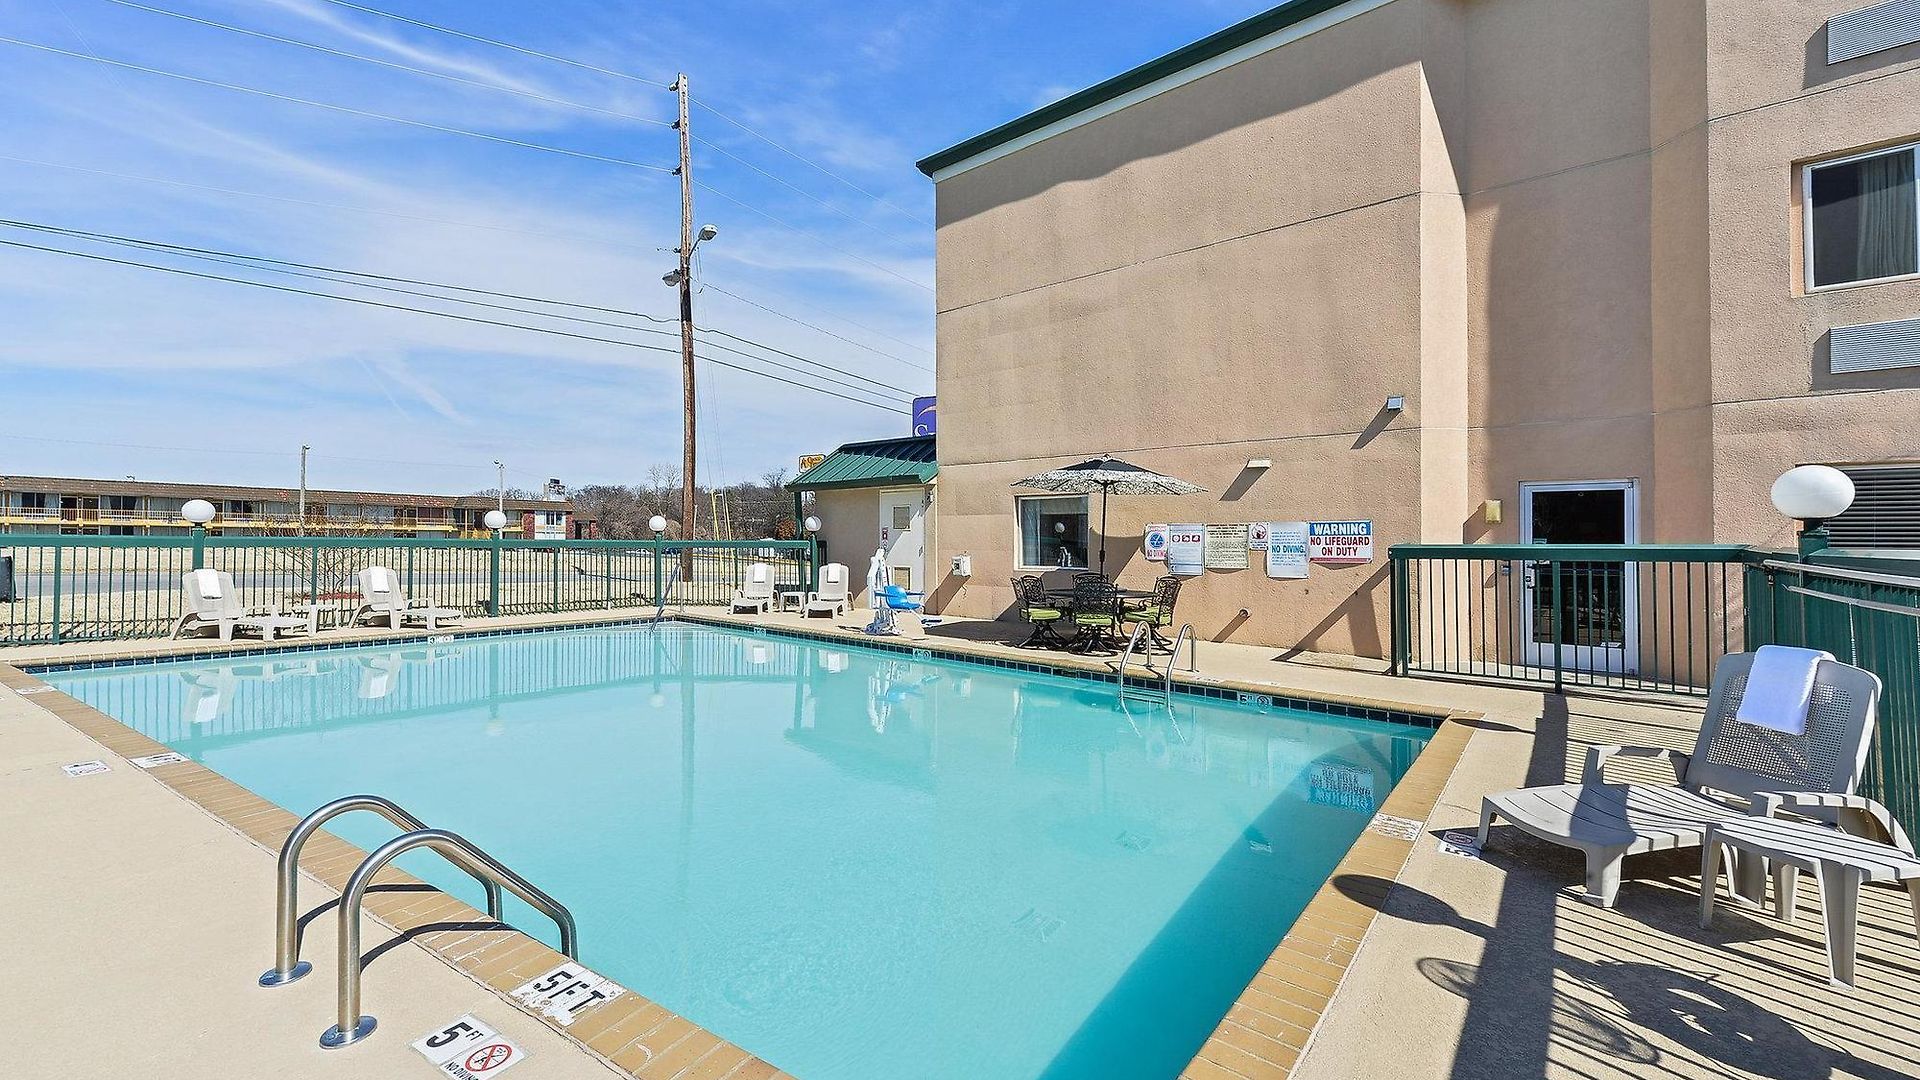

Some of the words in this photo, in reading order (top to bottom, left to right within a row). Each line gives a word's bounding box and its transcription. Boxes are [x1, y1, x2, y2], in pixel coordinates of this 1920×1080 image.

[1313, 523, 1367, 535] WARNING
[1310, 536, 1321, 546] NO
[1324, 536, 1370, 546] LIFEGUARD
[1271, 544, 1281, 553] NO
[1321, 546, 1333, 556] ON
[1336, 546, 1358, 556] DUTY
[426, 1021, 474, 1049] 5
[465, 1030, 484, 1041] FT
[444, 1061, 460, 1071] NO
